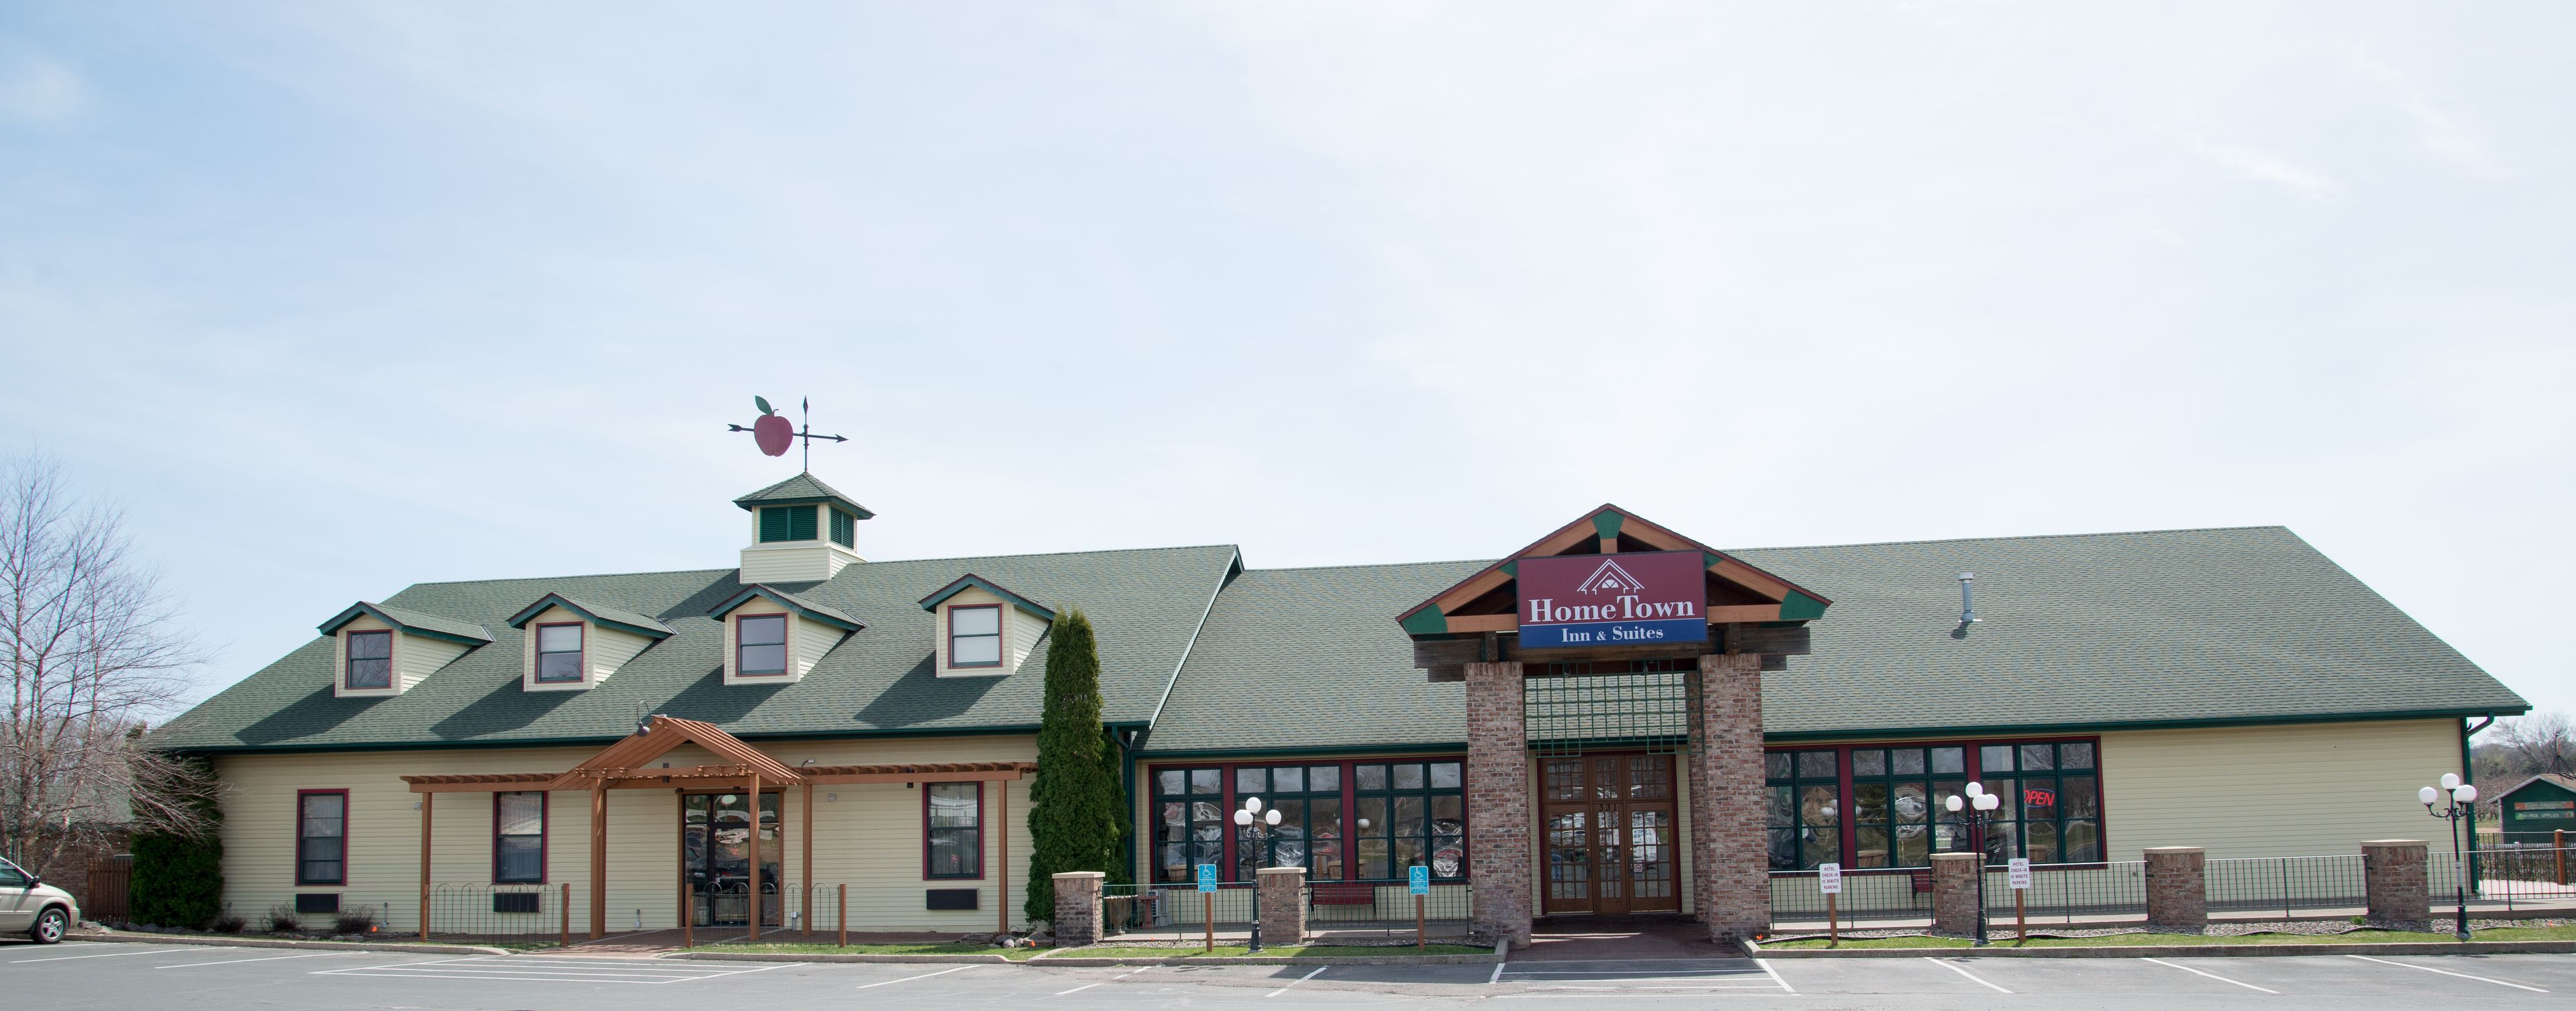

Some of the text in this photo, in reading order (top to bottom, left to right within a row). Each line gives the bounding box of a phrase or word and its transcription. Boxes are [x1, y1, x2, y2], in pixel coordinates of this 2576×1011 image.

[1529, 595, 1695, 623] HomeTown
[1561, 626, 1664, 643] Inn & Suites
[2023, 789, 2055, 806] OPEN
[1599, 804, 1616, 812] 331
